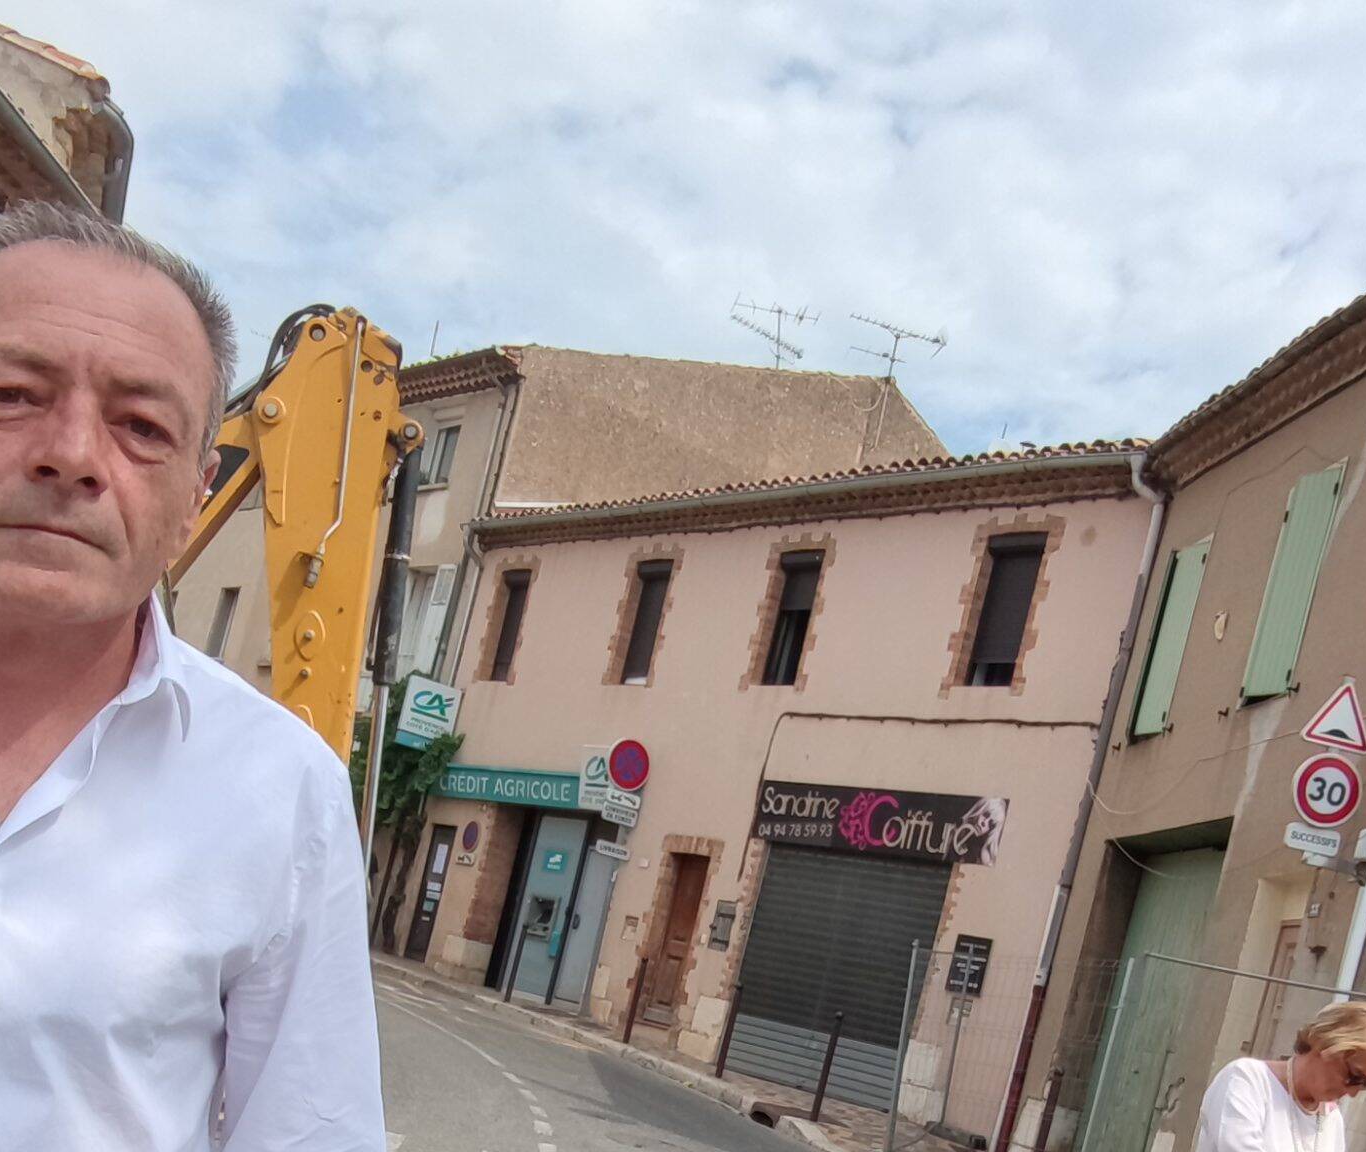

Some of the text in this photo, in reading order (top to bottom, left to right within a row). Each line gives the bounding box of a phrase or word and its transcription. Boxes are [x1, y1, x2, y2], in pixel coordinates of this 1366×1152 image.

[439, 771, 571, 802] CRÉDIT AGRICOLE
[1308, 776, 1347, 807] 30
[758, 823, 833, 838] 04 94 78 59 93
[863, 795, 976, 860] Coiffure
[1290, 830, 1338, 849] SUCCESSIFS
